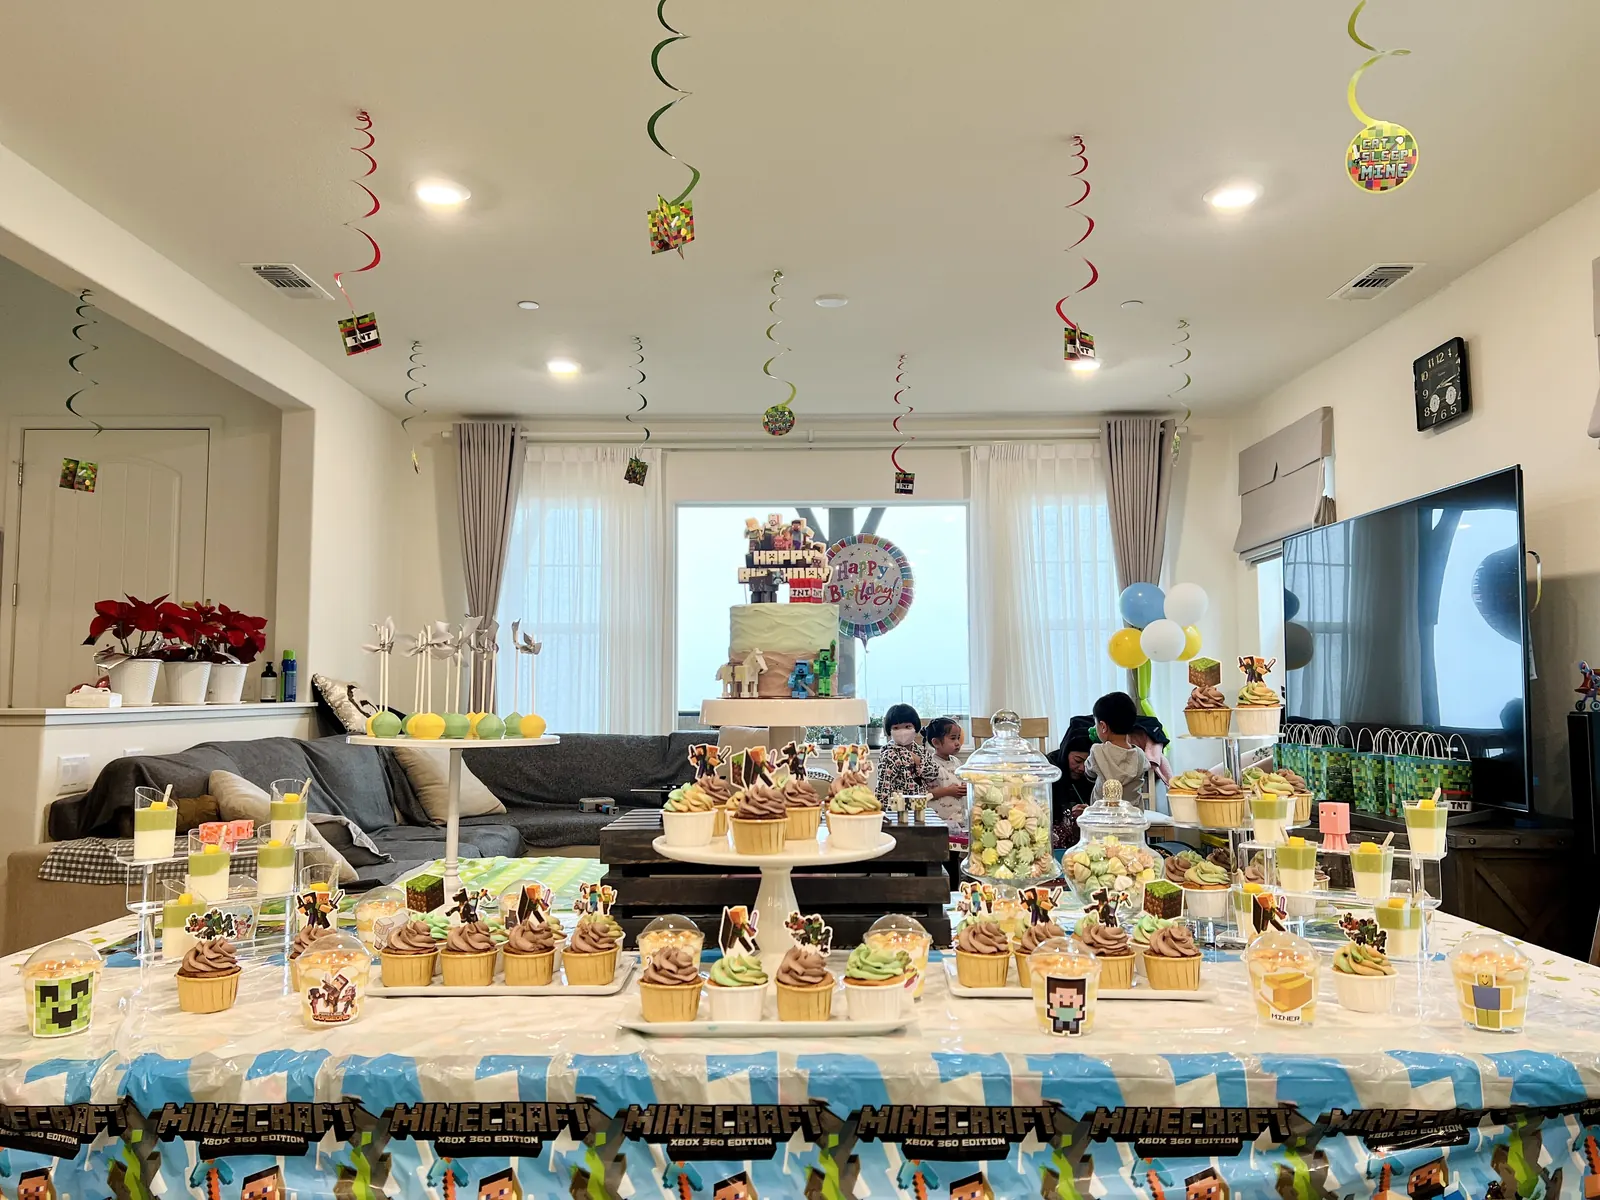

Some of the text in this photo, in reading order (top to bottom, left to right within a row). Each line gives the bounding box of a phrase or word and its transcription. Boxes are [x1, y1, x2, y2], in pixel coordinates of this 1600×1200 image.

[1362, 137, 1389, 150] EAT
[1361, 149, 1409, 162] SLEEP
[1360, 163, 1408, 180] MINE
[1428, 357, 1435, 369] 11
[1436, 351, 1445, 364] 12
[1422, 389, 1429, 399] 9
[1424, 406, 1431, 417] 8
[1440, 409, 1447, 419] 6
[1450, 403, 1457, 415] 5
[1431, 413, 1438, 424] 7
[753, 550, 815, 565] HAPPY
[739, 567, 830, 583] BIRHDAY
[837, 560, 889, 581] Happy
[828, 577, 900, 605] Birthday!
[1450, 801, 1468, 810] TNT
[1271, 1013, 1300, 1021] MINER
[156, 1102, 356, 1134] MINECRAFT
[388, 1102, 591, 1133] MINECRAFT
[622, 1104, 824, 1135] MINECRAFT
[856, 1105, 1055, 1136] MINECRAFT
[1089, 1106, 1291, 1137] MINECRAFT
[1368, 1123, 1464, 1140] XBOX 360 EDITION
[46, 1132, 79, 1145] EDITION
[201, 1134, 305, 1146] XBOX 360 EDITION
[437, 1135, 539, 1144] XBOX 360 EDITION
[670, 1137, 773, 1147] XBOX 360 EDITION
[904, 1137, 1006, 1148] XBOX 360 EDITION
[1138, 1136, 1239, 1146] XBOX 360 EDITION
